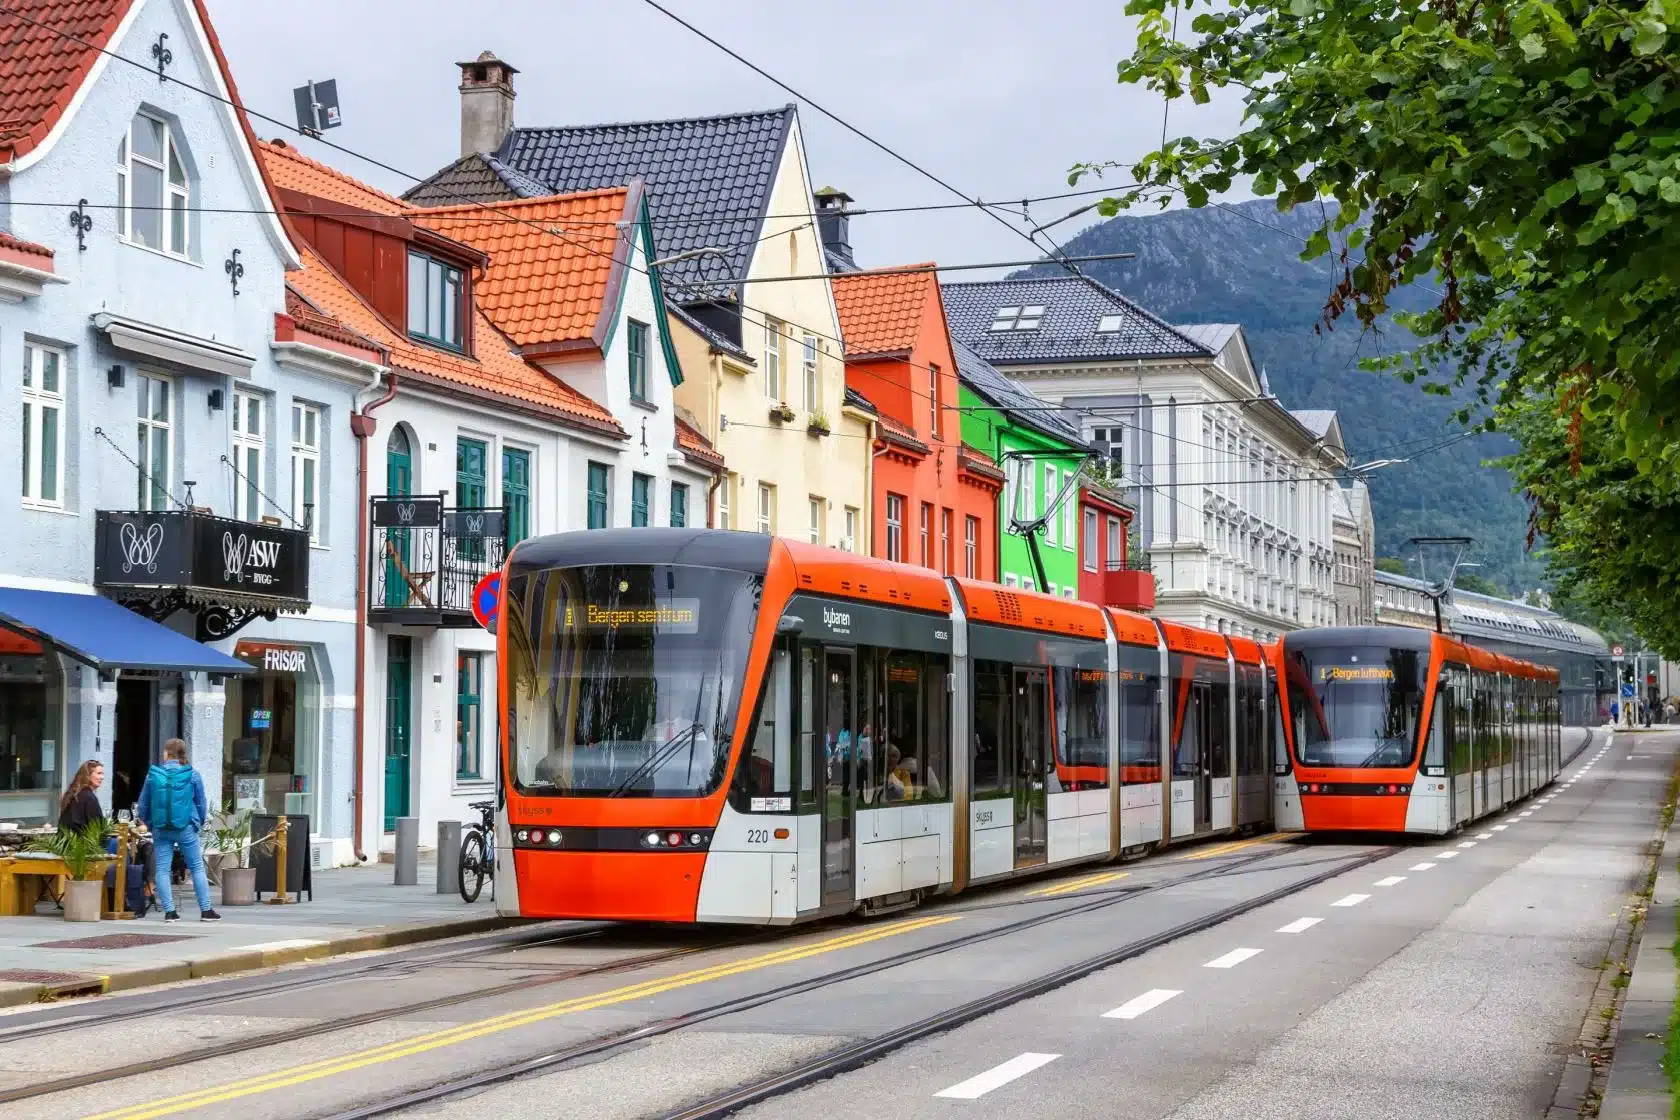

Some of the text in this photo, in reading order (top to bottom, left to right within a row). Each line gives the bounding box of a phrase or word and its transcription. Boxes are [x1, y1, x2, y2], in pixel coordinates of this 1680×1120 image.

[245, 539, 281, 569] ASW
[253, 572, 272, 584] BYGG
[588, 605, 635, 629] Bergen
[637, 604, 692, 623] sentrum
[823, 607, 851, 627] bybanen
[264, 648, 306, 672] FRISØR
[1333, 667, 1360, 680] Bergen
[253, 710, 271, 719] OPEN
[747, 829, 769, 844] 220
